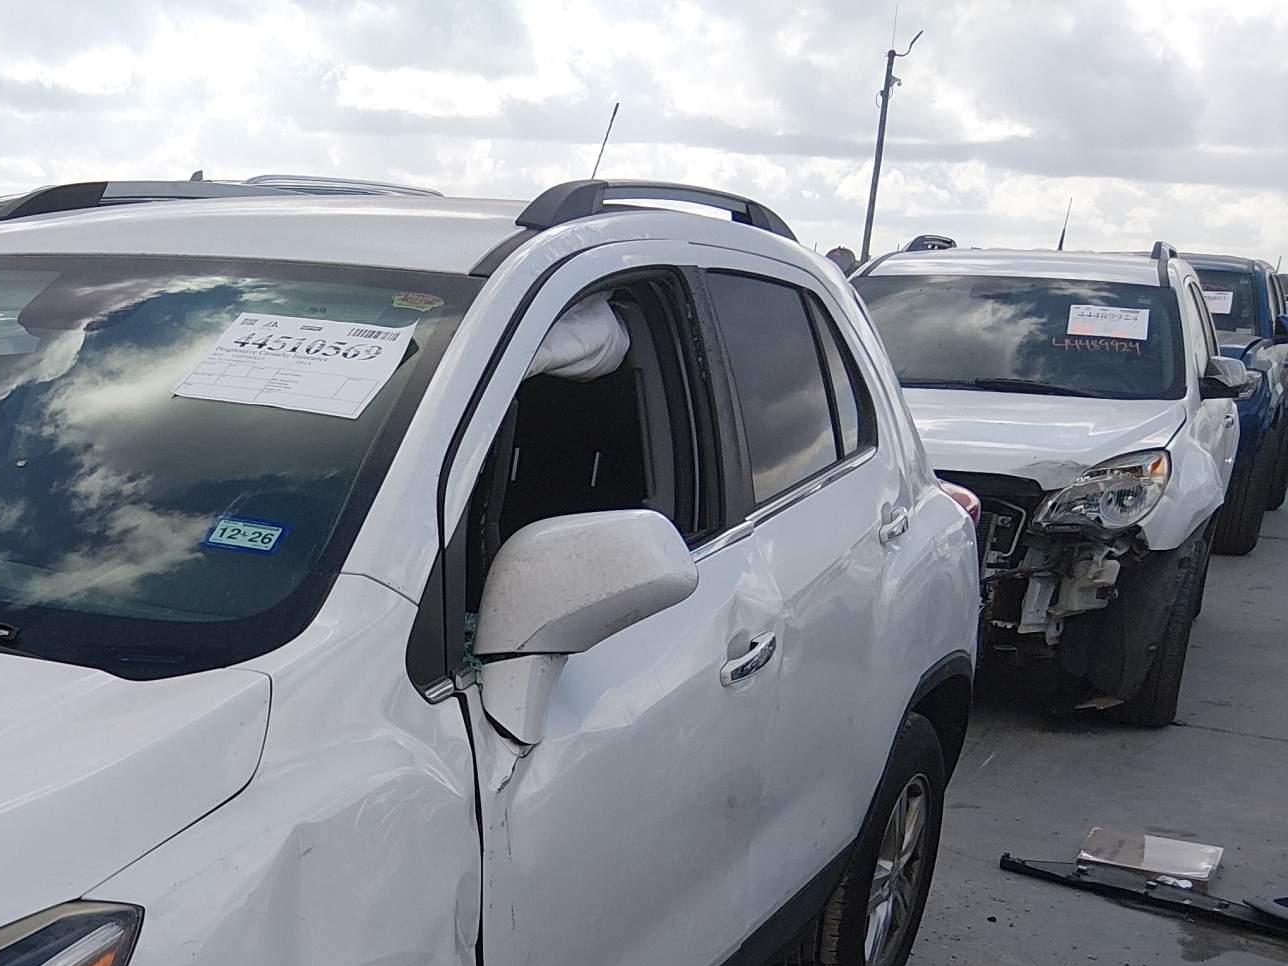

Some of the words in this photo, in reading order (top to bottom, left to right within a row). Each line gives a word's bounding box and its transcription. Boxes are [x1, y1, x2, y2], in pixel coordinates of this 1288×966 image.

[215, 346, 258, 355] Progressive
[258, 349, 290, 358] Casualty
[233, 332, 383, 361] 44510569
[1053, 337, 1141, 355] 44489924
